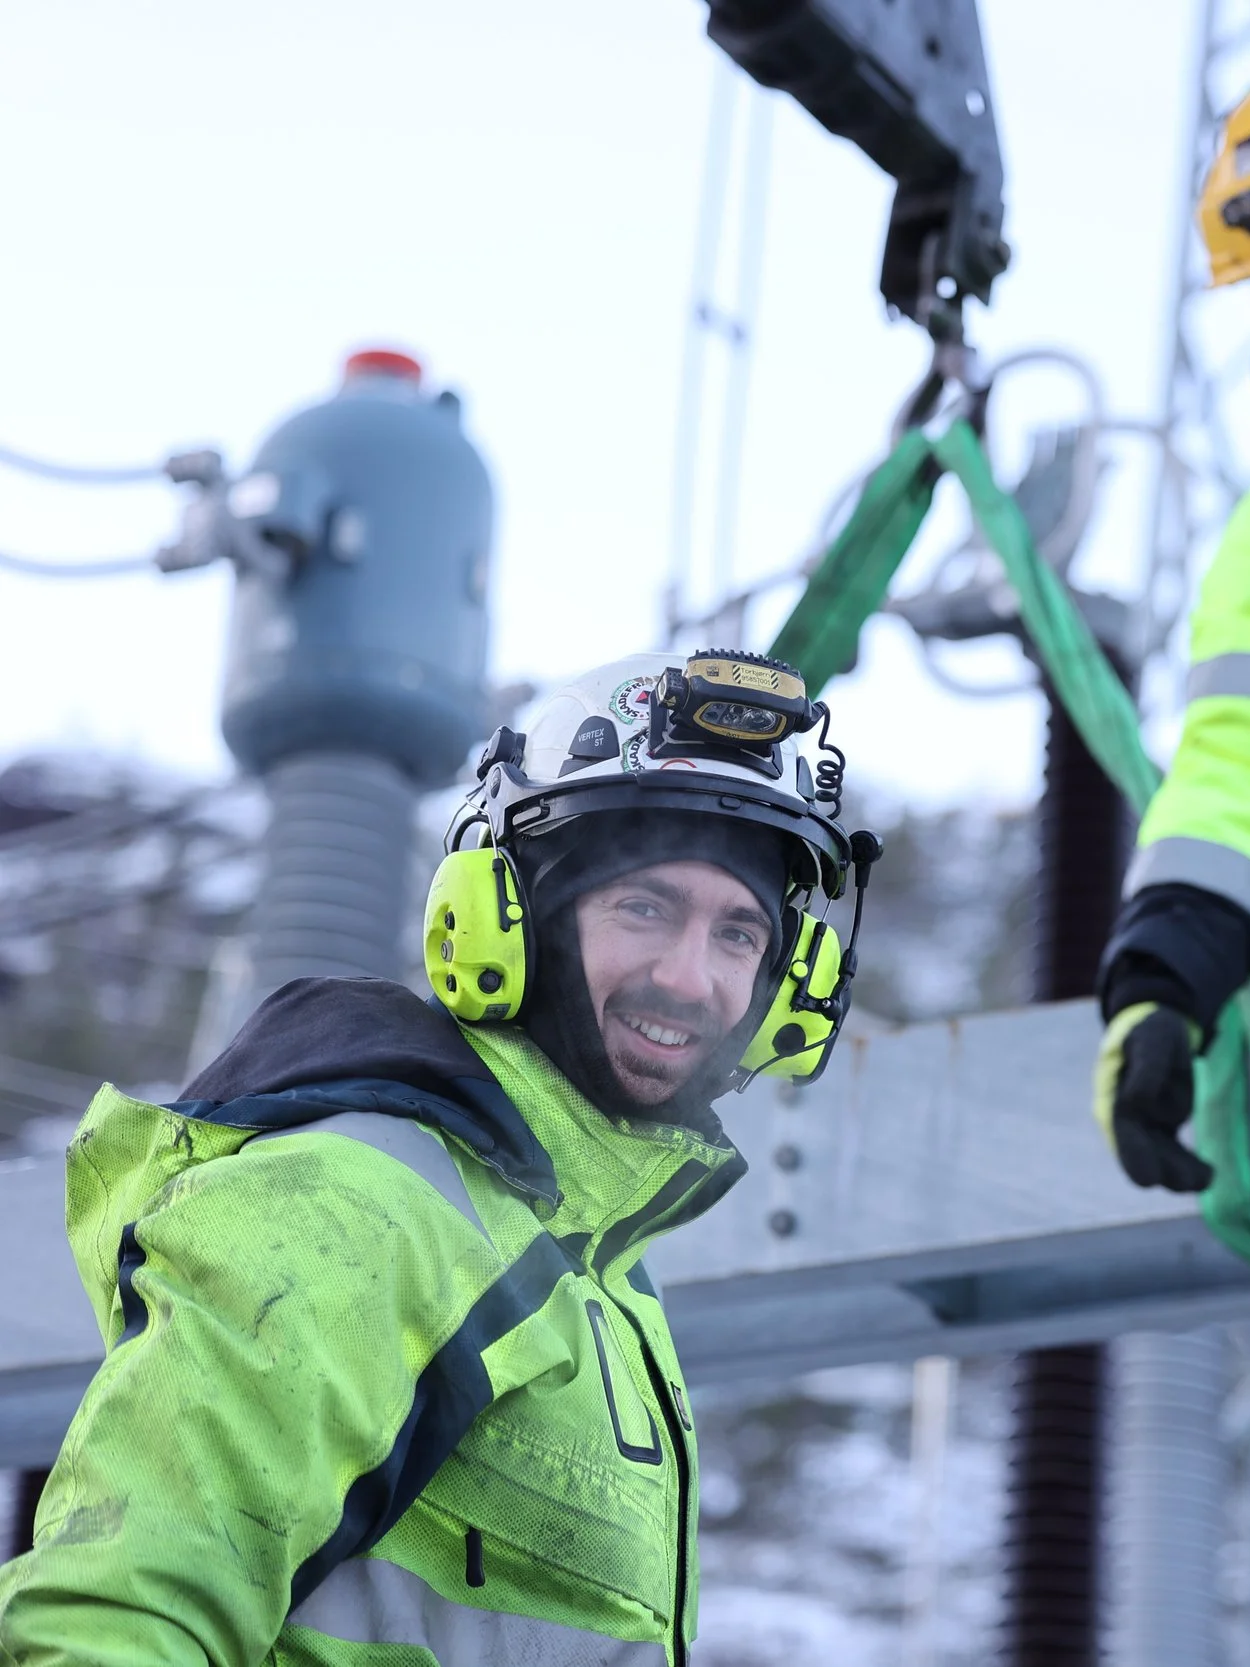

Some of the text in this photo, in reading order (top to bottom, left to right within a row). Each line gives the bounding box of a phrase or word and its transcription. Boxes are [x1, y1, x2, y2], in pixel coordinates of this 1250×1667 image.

[618, 682, 645, 718] SKADEFR
[578, 727, 605, 743] VERTEX
[594, 737, 604, 747] ST
